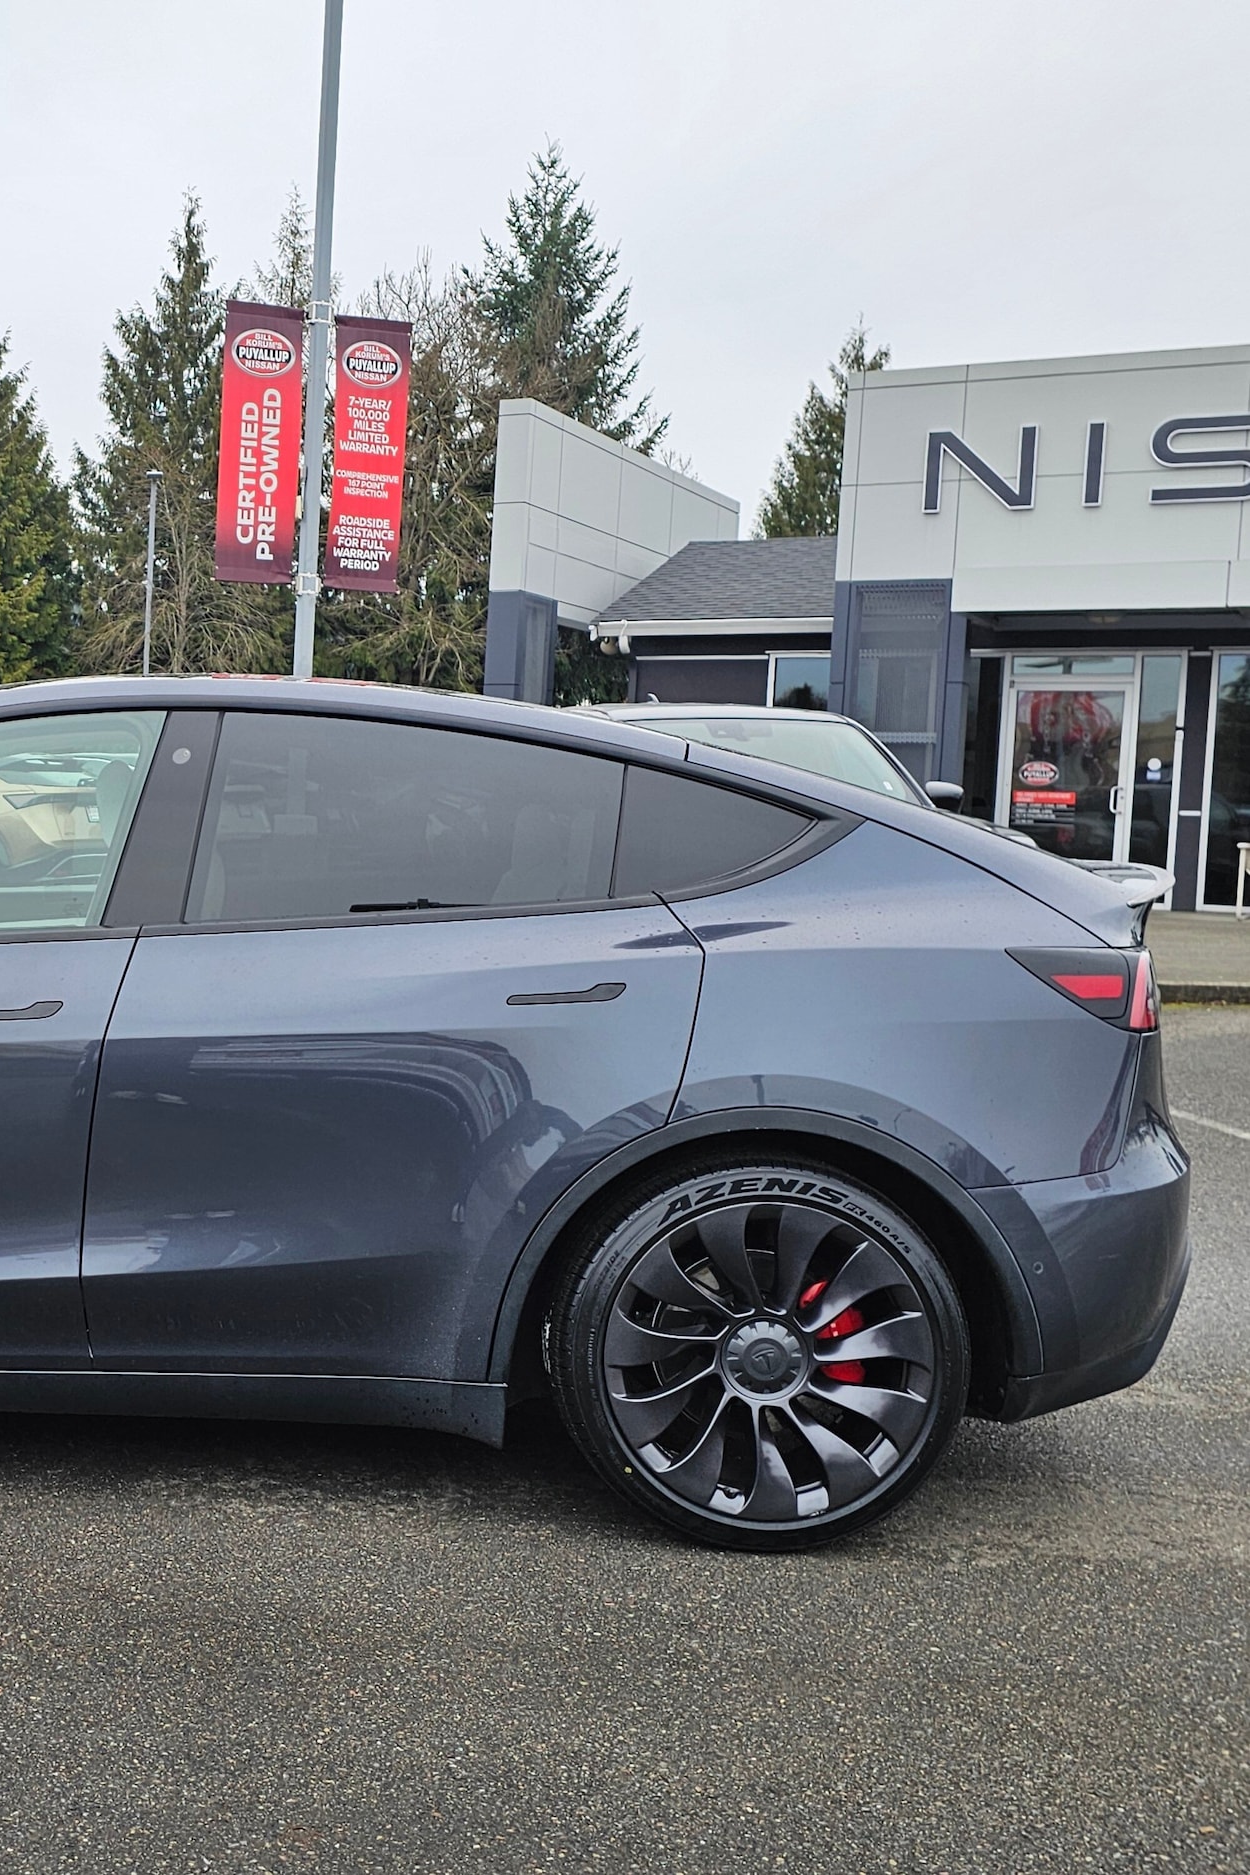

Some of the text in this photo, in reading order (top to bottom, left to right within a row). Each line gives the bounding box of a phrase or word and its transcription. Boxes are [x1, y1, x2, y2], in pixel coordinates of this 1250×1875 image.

[246, 339, 283, 349] KORUM'S
[255, 333, 273, 341] BILL
[239, 347, 289, 362] PUYALLUP
[355, 351, 390, 361] KORUM'S
[364, 345, 380, 353] BILL
[245, 360, 280, 370] NISSAN
[349, 358, 396, 374] PUYALLUP
[355, 371, 387, 382] NISSAN
[349, 396, 392, 411] 7-YEAR/
[347, 407, 390, 421] 100,000
[354, 419, 385, 432] MILES
[348, 430, 389, 444] LIMITED
[339, 440, 398, 456] WARRANTY
[236, 402, 259, 544] CERTIFIED
[256, 388, 281, 561] PRE-OWNED
[336, 469, 399, 484] COMPREHENSIVE
[348, 479, 385, 490] 167 POINT
[344, 486, 388, 499] INSPECTION
[339, 515, 390, 529] ROADSIDE
[332, 525, 395, 540] ASSISTANCE
[338, 537, 386, 550] FOR FULL
[333, 547, 391, 561] WARRANTY
[340, 559, 380, 571] PERIOD
[657, 1177, 849, 1229] AZENIS
